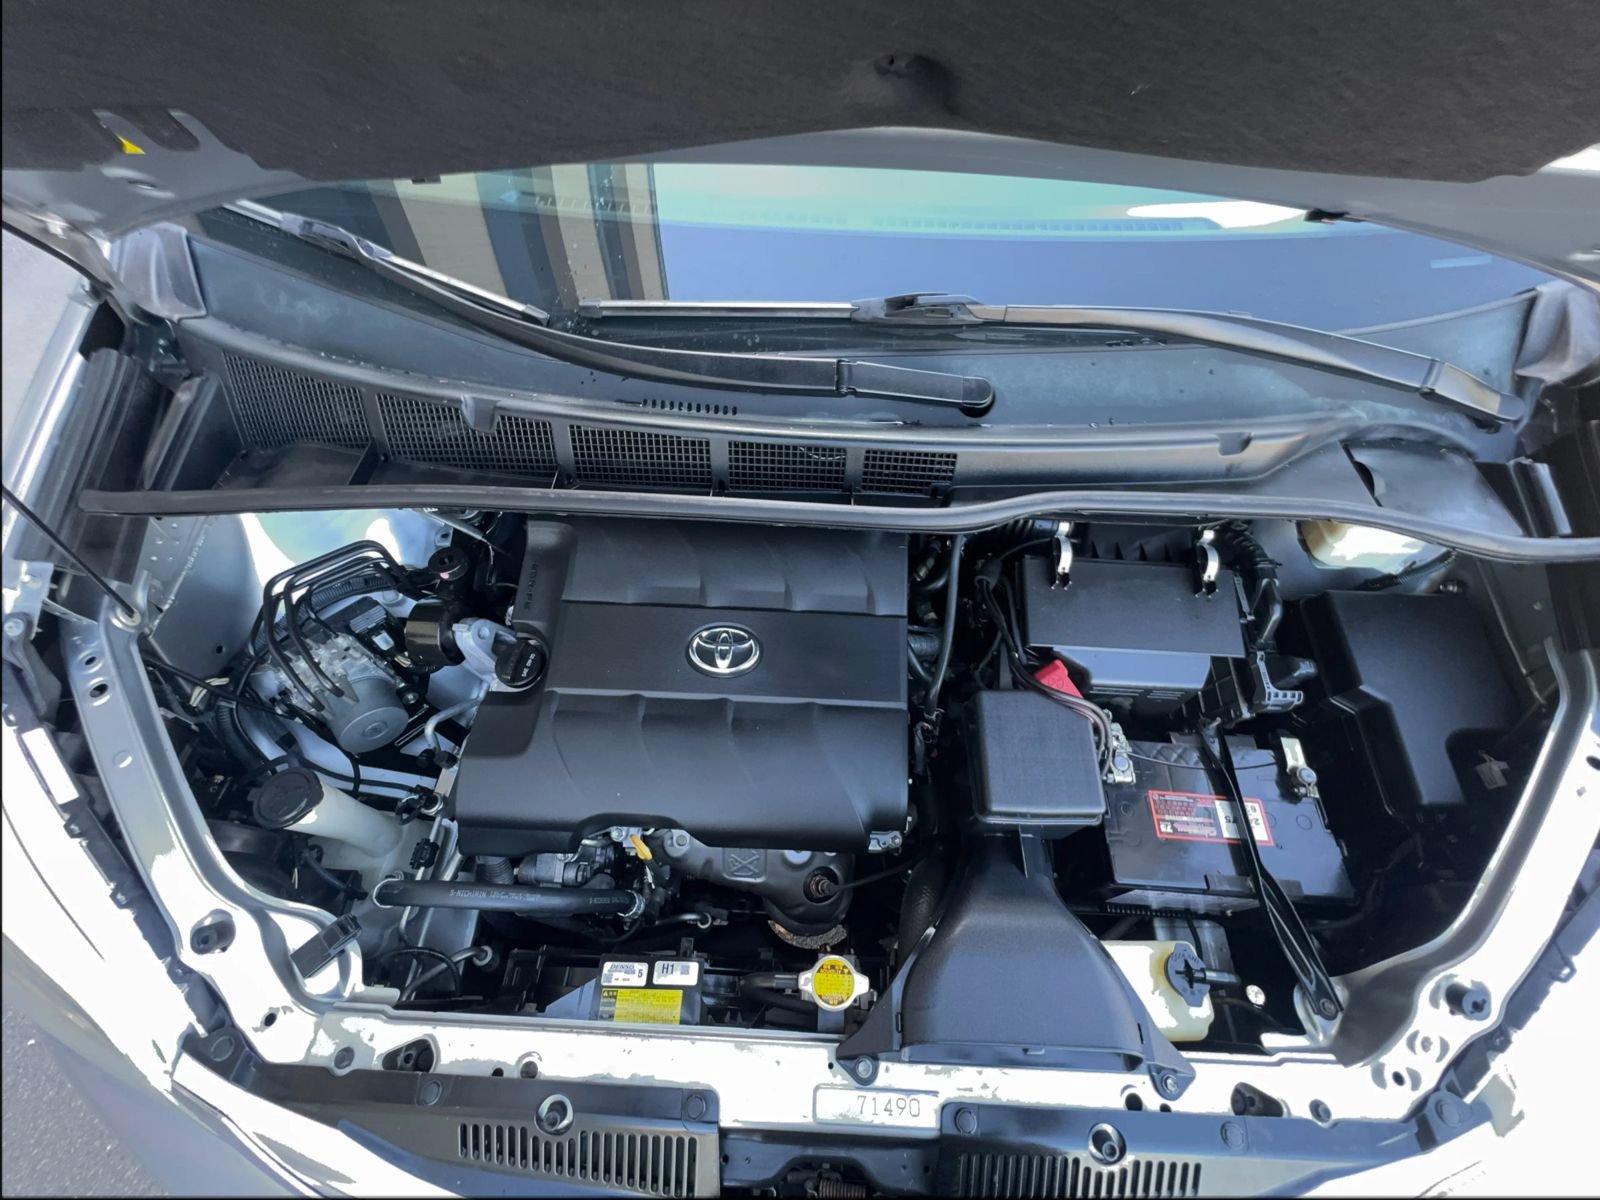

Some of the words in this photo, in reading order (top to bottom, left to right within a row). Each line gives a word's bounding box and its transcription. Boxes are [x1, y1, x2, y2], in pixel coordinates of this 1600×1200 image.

[637, 969, 644, 979] 5
[661, 962, 675, 975] H1
[856, 1095, 921, 1118] 71490
